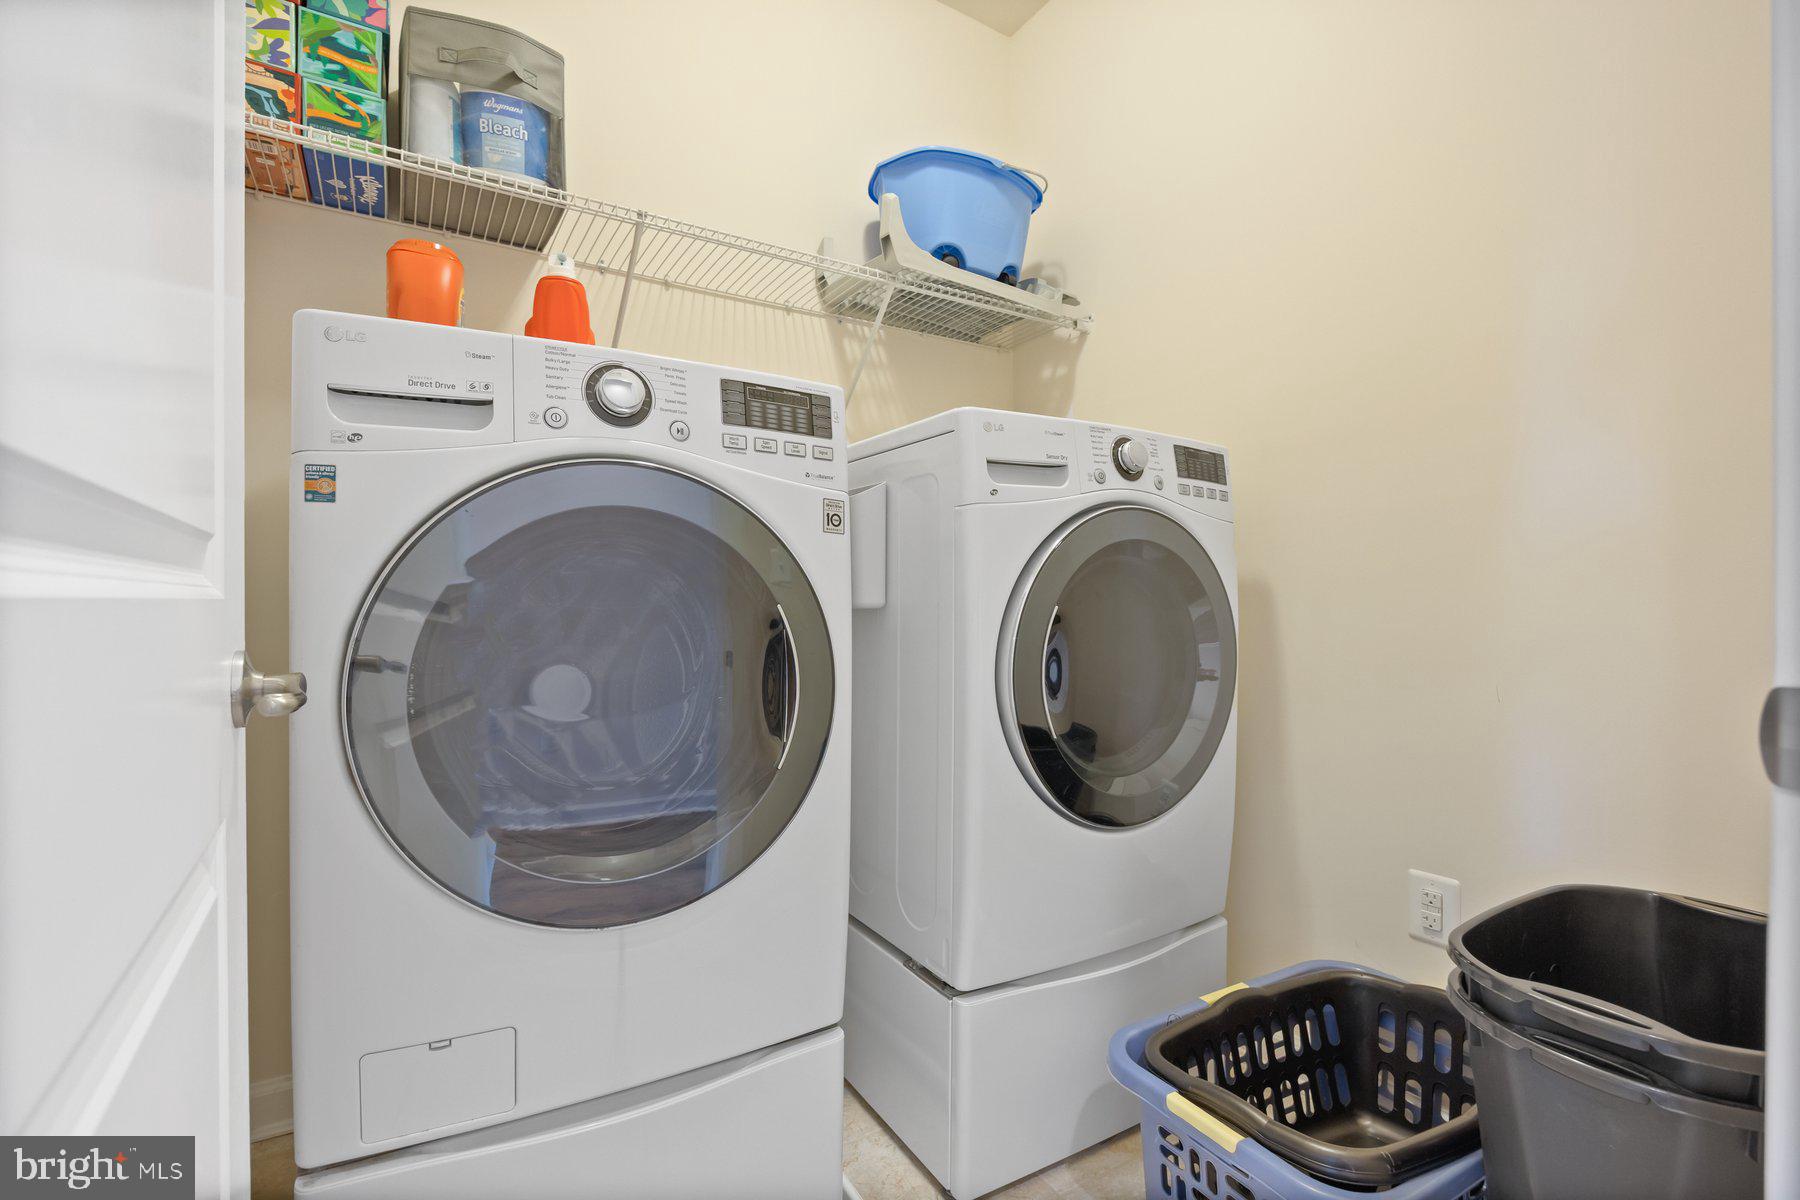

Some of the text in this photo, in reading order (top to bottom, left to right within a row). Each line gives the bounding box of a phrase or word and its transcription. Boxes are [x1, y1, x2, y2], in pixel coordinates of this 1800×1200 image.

[483, 97, 524, 114] Wegmans
[479, 118, 529, 141] Bleach
[345, 330, 367, 342] LG
[408, 379, 456, 390] Direct Drive
[993, 424, 1004, 432] LG
[826, 513, 842, 527] 10
